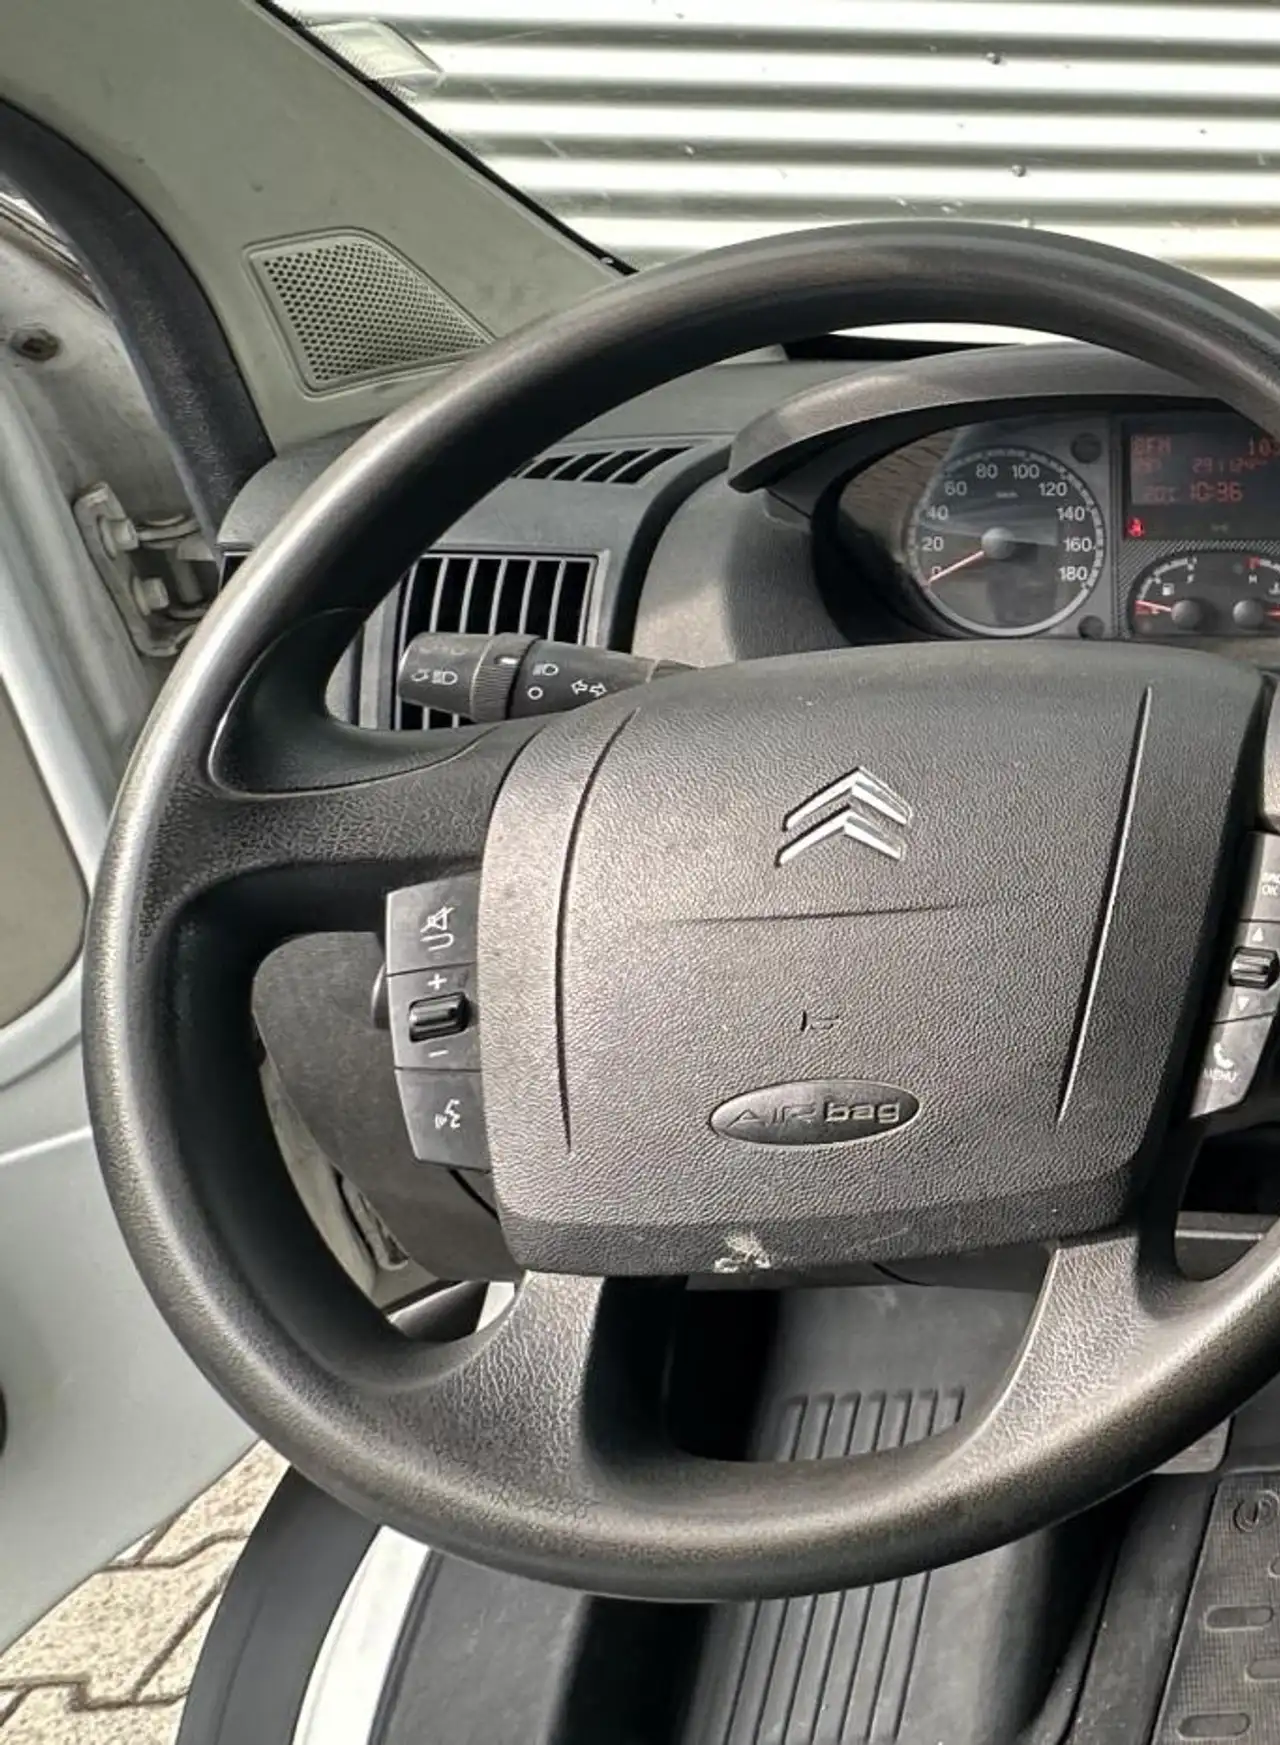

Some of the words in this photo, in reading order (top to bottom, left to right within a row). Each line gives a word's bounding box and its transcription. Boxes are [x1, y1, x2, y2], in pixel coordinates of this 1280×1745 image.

[975, 463, 999, 480] 80
[1011, 464, 1040, 480] 100
[944, 481, 968, 497] 60
[1038, 481, 1068, 497] 120
[926, 505, 949, 521] 40
[1056, 506, 1085, 522] 140
[921, 535, 945, 552] 20
[1063, 537, 1092, 552] 160
[1059, 566, 1088, 582] 180
